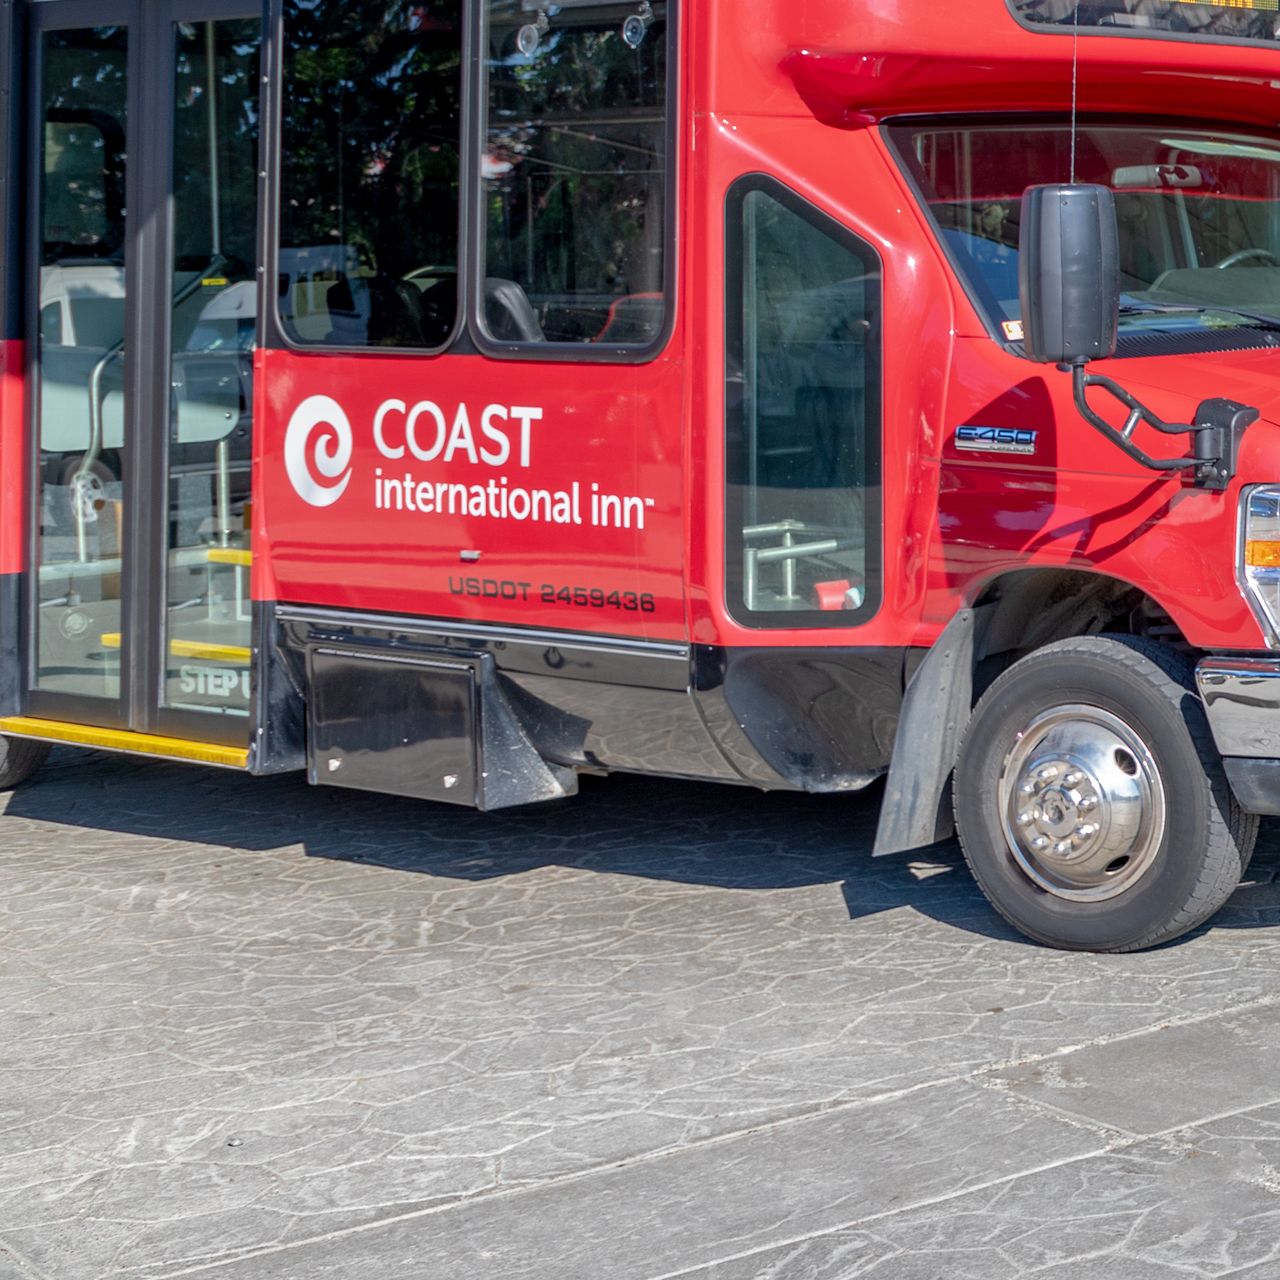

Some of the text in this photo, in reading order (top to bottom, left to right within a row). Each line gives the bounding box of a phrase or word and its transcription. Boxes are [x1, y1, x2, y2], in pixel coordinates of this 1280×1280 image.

[373, 398, 543, 467] COAST
[375, 468, 582, 524] international
[448, 576, 656, 613] USDOT 2459436
[180, 664, 239, 697] STEP
